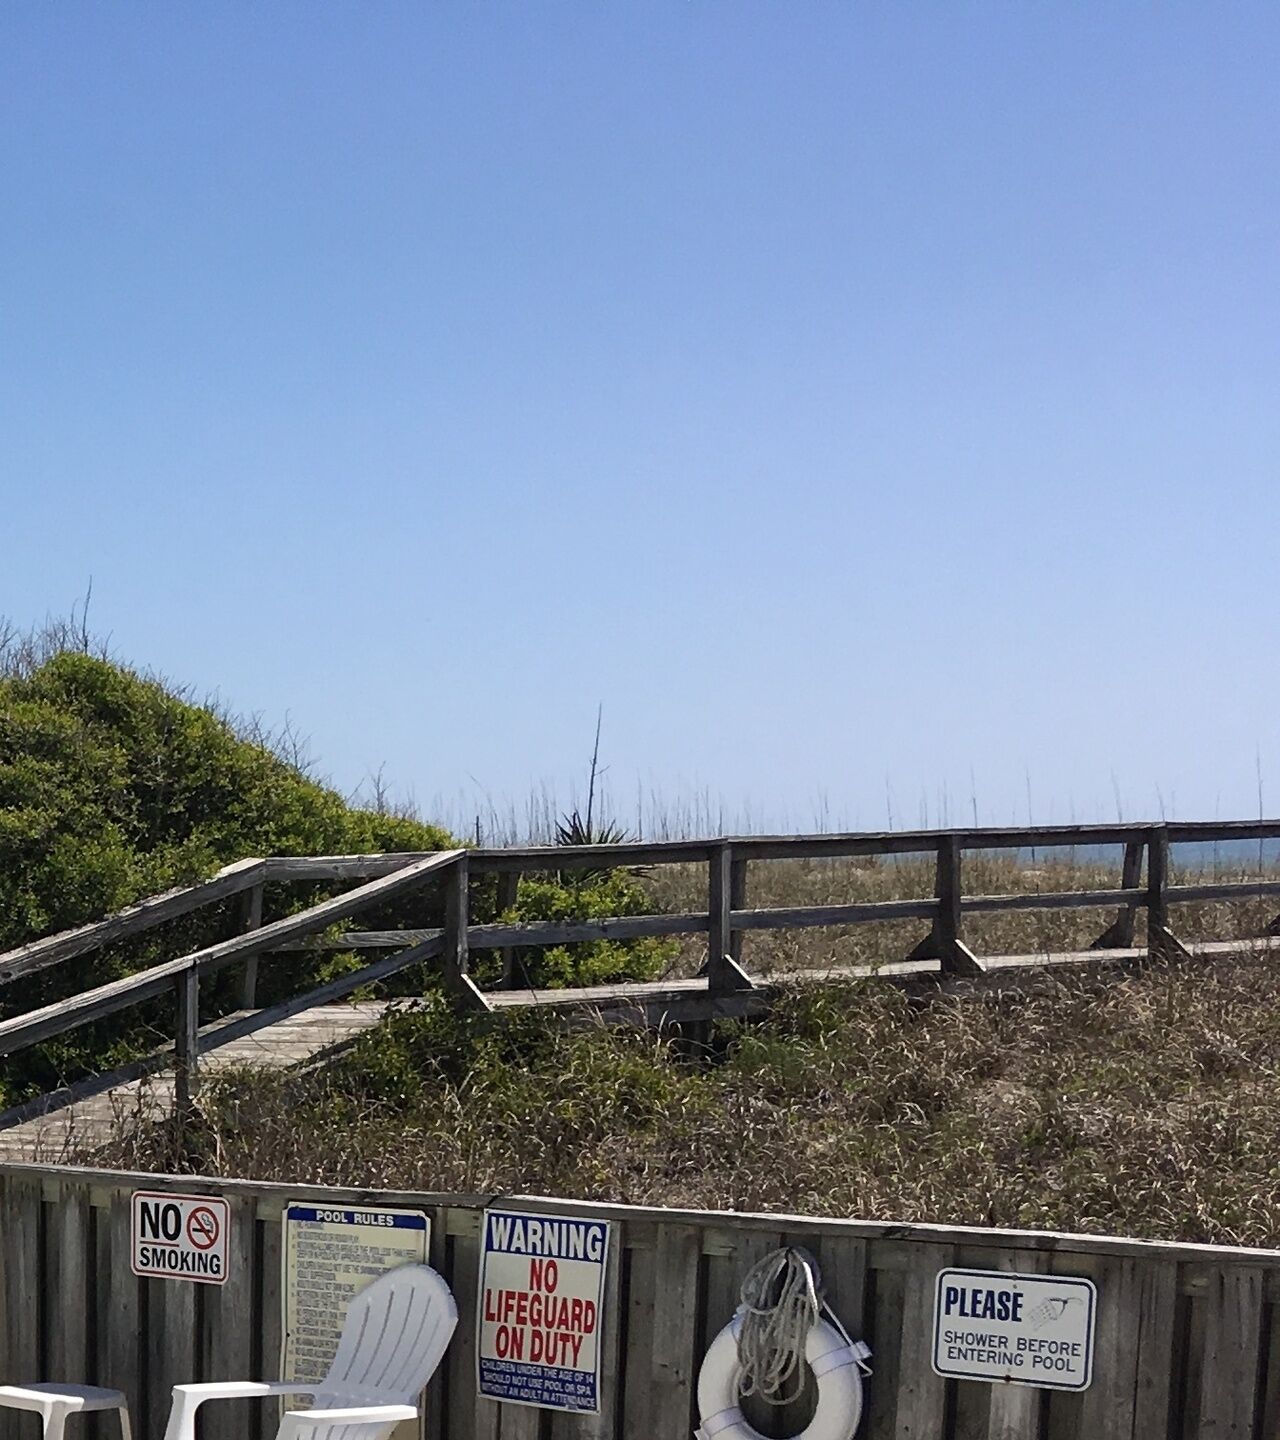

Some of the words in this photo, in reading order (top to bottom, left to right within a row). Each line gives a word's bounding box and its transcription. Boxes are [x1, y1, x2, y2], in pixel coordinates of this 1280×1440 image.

[140, 1202, 182, 1241] NO
[315, 1210, 349, 1224] POOL
[353, 1213, 395, 1227] RULES
[491, 1216, 603, 1261] WARNING
[140, 1246, 221, 1275] SMOKING
[529, 1258, 558, 1294] NO
[484, 1288, 596, 1334] LIFEGUARD
[944, 1286, 1024, 1323] PLEASE
[496, 1325, 524, 1360] ON
[530, 1329, 584, 1368] DUTY
[943, 1330, 1009, 1349] SHOWER
[1016, 1337, 1081, 1357] BEFORE
[481, 1361, 516, 1374] CHILDREN
[517, 1365, 542, 1377] UNDER
[543, 1368, 557, 1379] THE
[558, 1370, 573, 1381] AGE
[574, 1372, 584, 1382] OF
[947, 1346, 1024, 1367] ENTERING
[1032, 1356, 1076, 1373] POOL
[481, 1382, 508, 1395] WITHOUT
[508, 1386, 519, 1396] AN
[520, 1388, 542, 1400] ADULT
[542, 1391, 550, 1401] IN
[551, 1391, 596, 1408] ATTENDANCE
[483, 1372, 511, 1384] SHOULD
[511, 1375, 526, 1387] NOT
[527, 1378, 543, 1389] USE
[544, 1380, 563, 1392] POOL
[564, 1383, 575, 1393] OR
[576, 1385, 591, 1396] SPA
